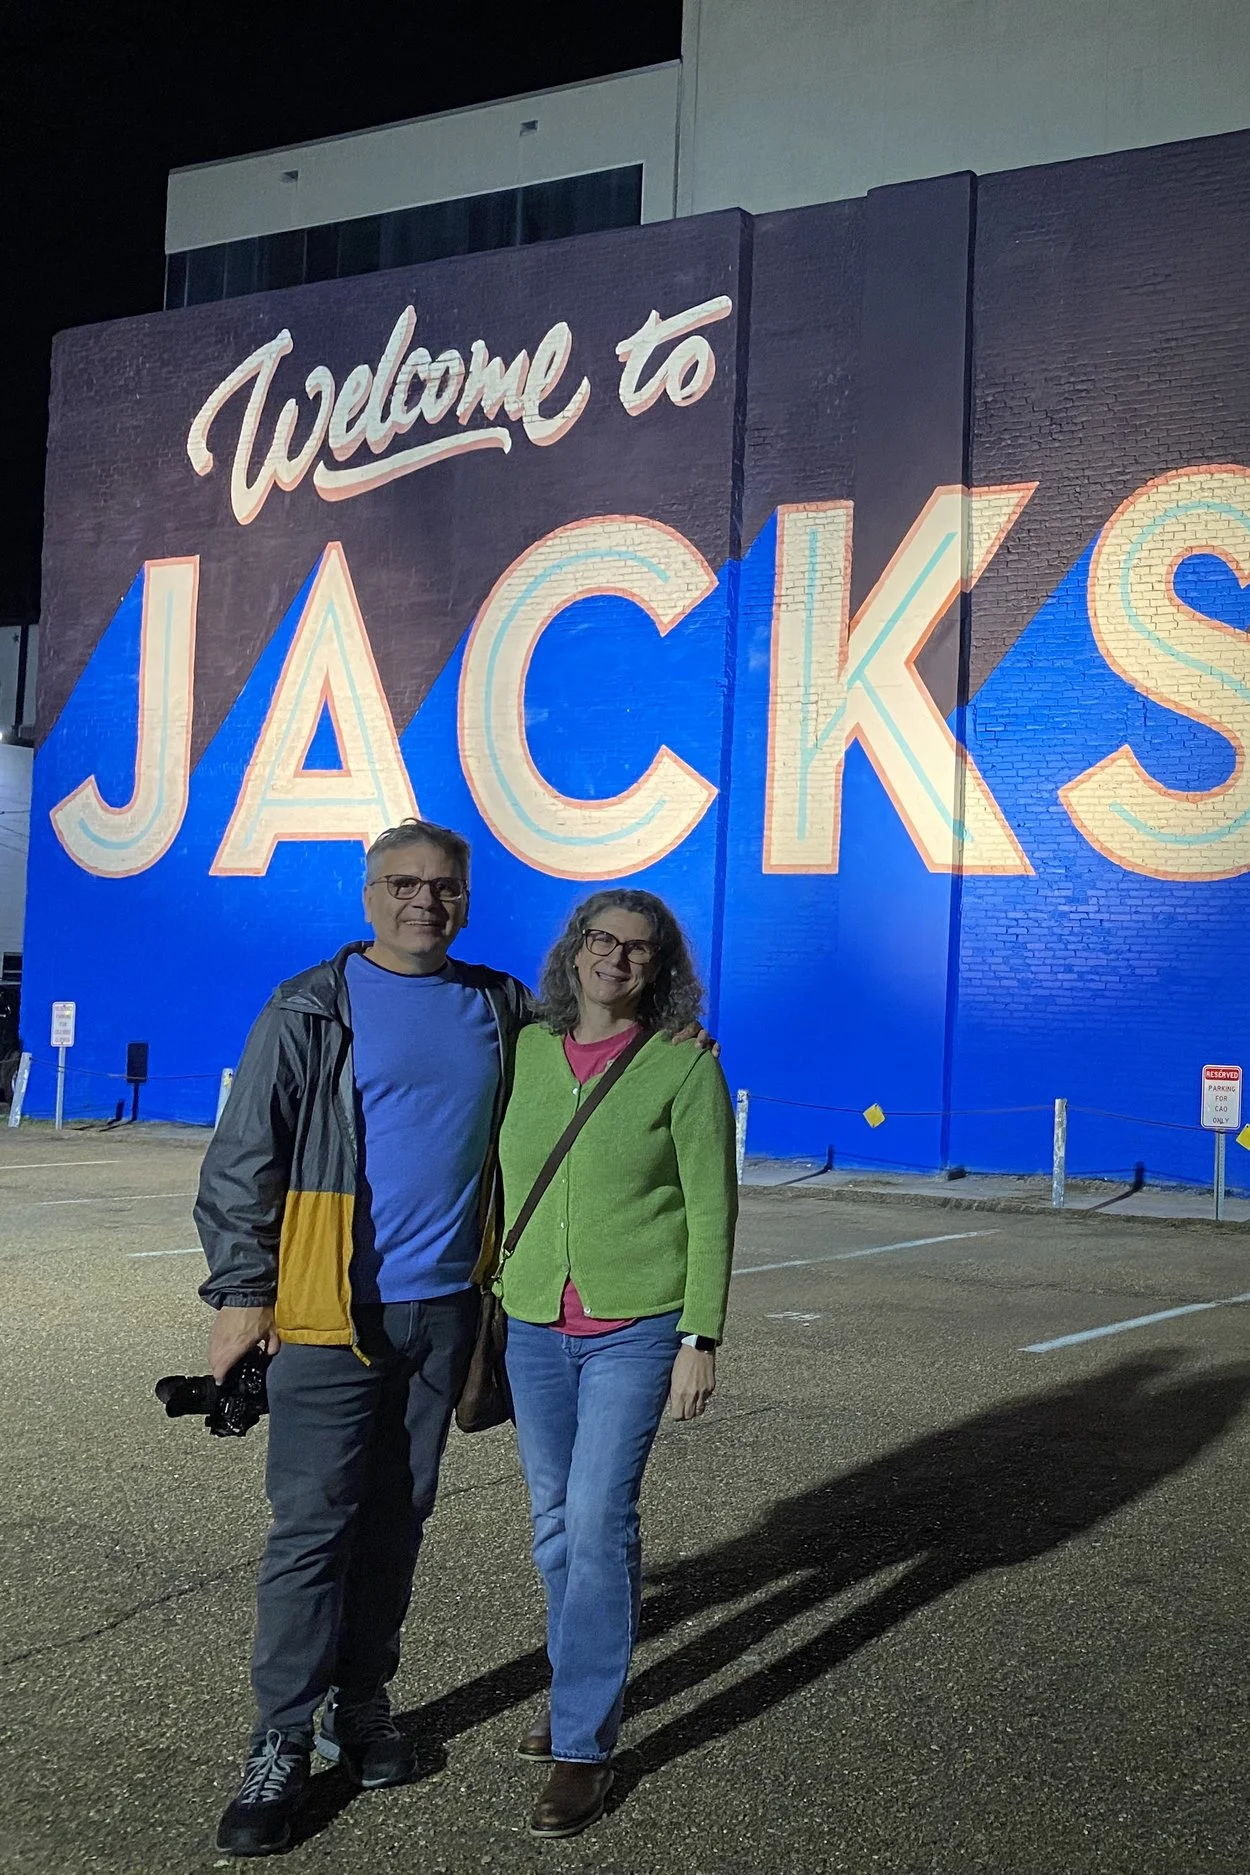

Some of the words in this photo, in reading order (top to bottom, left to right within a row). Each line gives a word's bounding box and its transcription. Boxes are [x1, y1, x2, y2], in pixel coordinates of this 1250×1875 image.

[187, 304, 591, 525] Welcome
[615, 295, 732, 416] to
[1206, 1070, 1239, 1079] RESERVED
